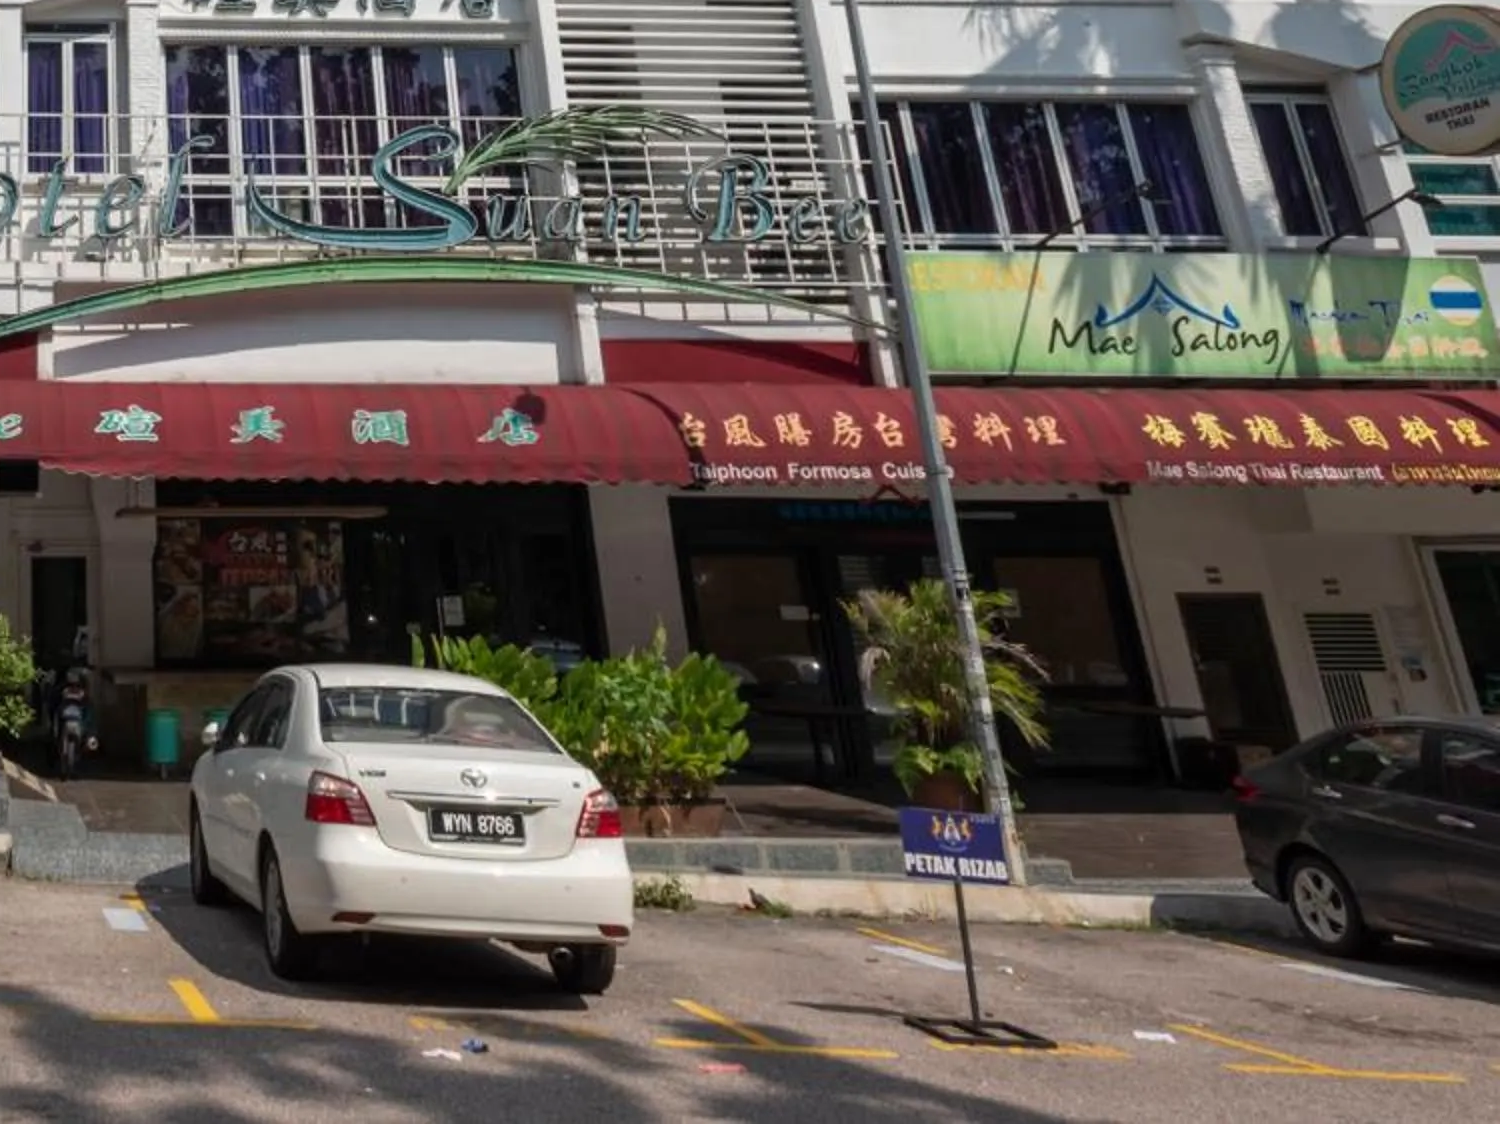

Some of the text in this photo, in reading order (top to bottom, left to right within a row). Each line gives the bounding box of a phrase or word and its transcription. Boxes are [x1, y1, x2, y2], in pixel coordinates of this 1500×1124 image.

[1424, 97, 1491, 124] RESTORAN
[1446, 114, 1475, 131] THAI
[247, 124, 649, 250] Suan
[686, 154, 869, 243] Bee
[1048, 317, 1138, 355] Mae
[1171, 314, 1280, 364] Salong
[689, 462, 955, 482] Taiphoon Formosa Cuise
[1185, 461, 1247, 483] Salong
[1290, 463, 1385, 480] Restaurant
[441, 812, 473, 833] WYN
[904, 852, 1009, 879] PETAK RIZAB
